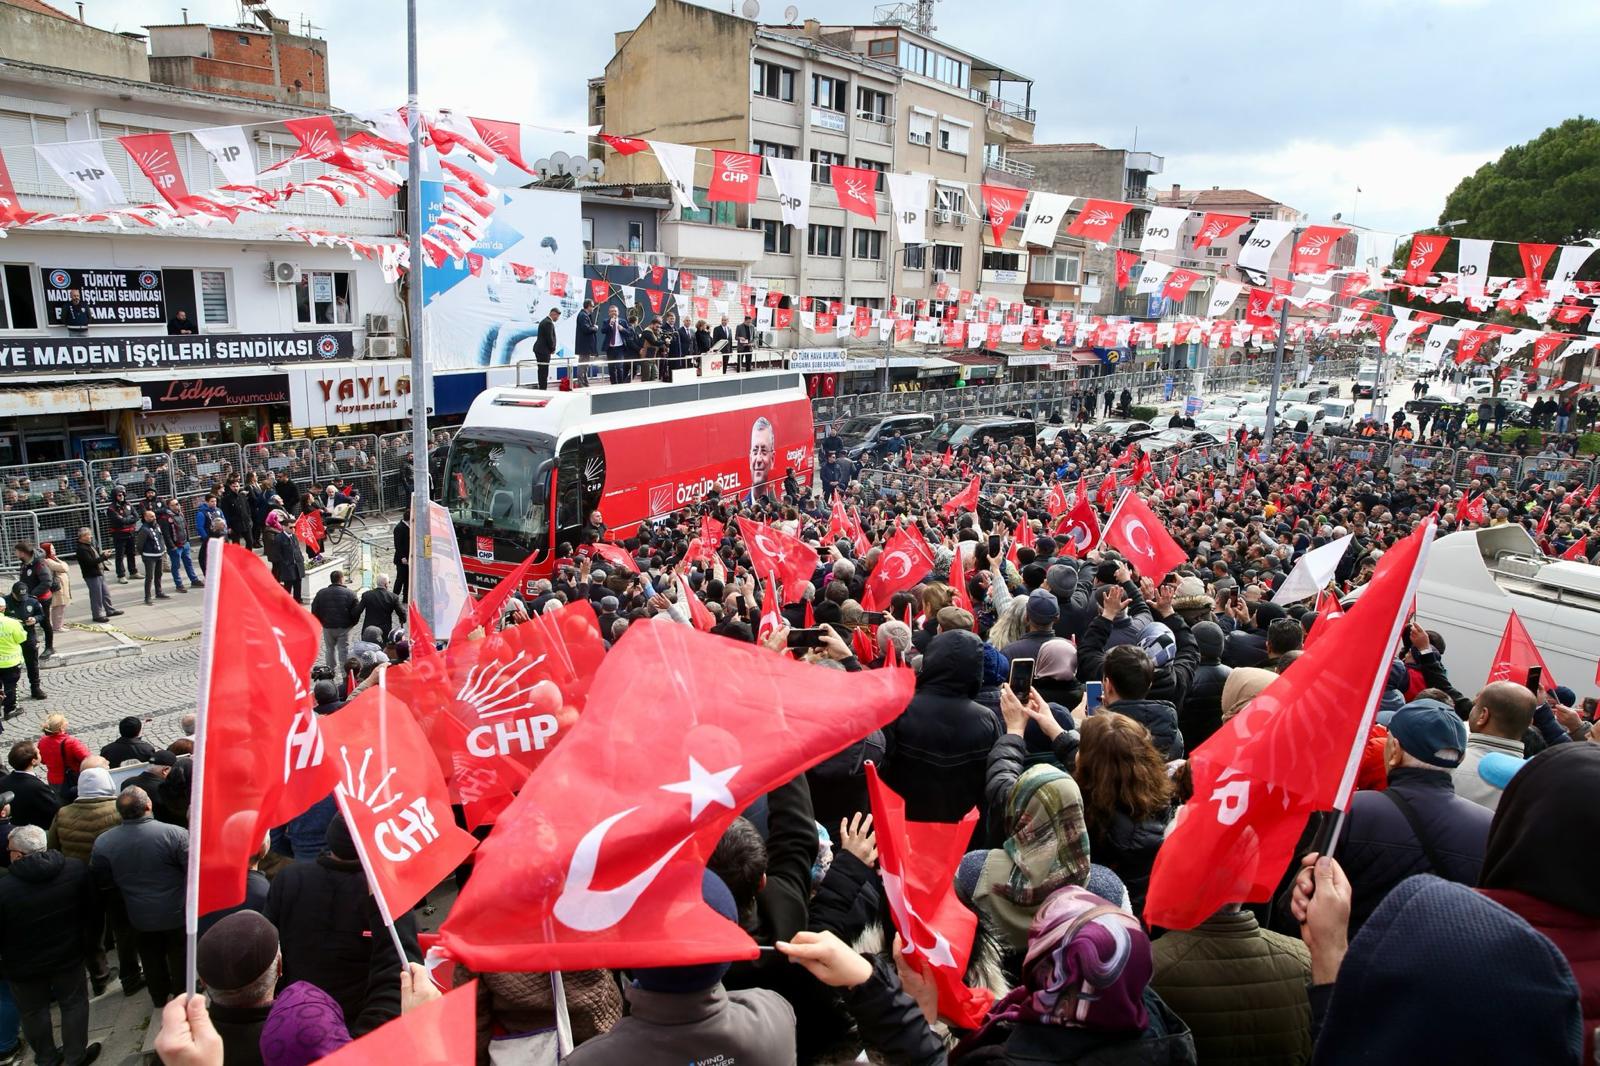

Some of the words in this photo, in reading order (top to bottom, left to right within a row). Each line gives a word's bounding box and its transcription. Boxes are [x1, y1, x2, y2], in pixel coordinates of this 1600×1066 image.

[722, 171, 749, 183] CHP
[780, 193, 802, 210] CHP
[82, 271, 127, 287] TÜRKİYE
[81, 287, 117, 304] İŞÇİLERİ
[118, 288, 162, 302] SENDİKASI
[117, 304, 160, 322] ŞUBESİ
[1213, 300, 1230, 310] CHP
[33, 345, 120, 366] MADEN
[126, 339, 211, 368] İŞÇİLERİ
[215, 337, 313, 359] SENDİKASI
[160, 379, 227, 406] Lidya
[226, 391, 285, 405] kuyumculuk
[335, 400, 397, 414] Kuyumculuk
[587, 483, 602, 492] CHP
[478, 551, 493, 559] CHP
[476, 575, 498, 584] MAN
[466, 714, 559, 758] CHP
[374, 797, 440, 863] CHP
[697, 1054, 724, 1066] WIND
